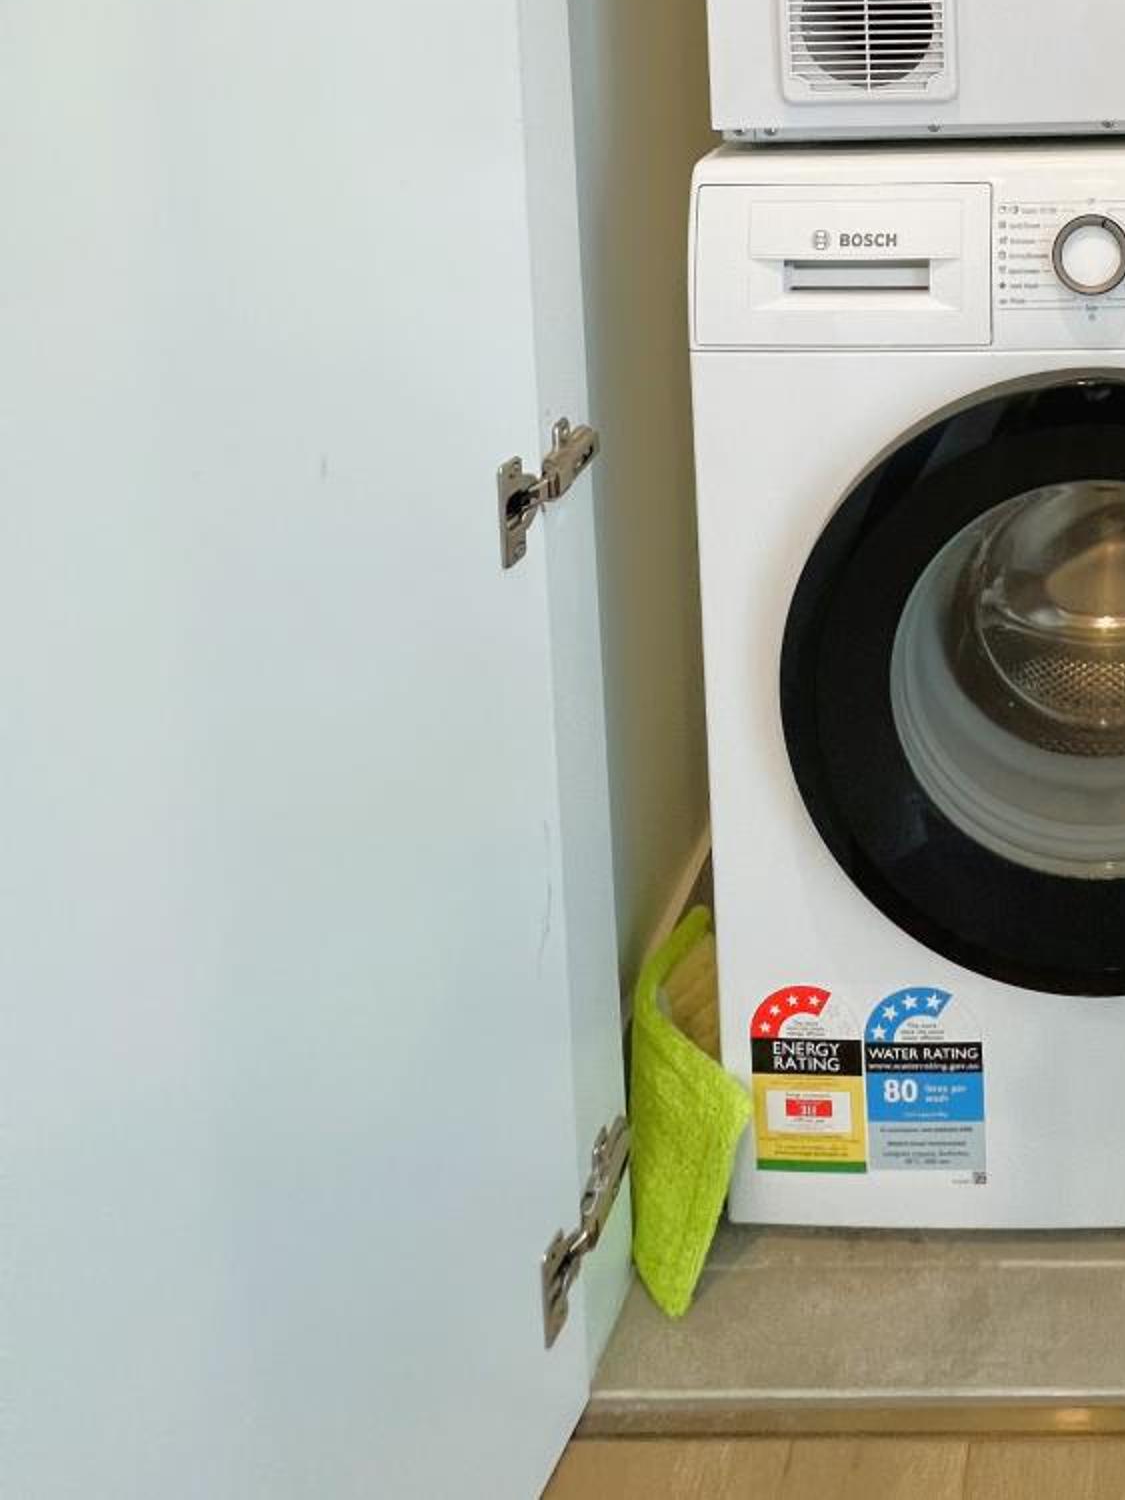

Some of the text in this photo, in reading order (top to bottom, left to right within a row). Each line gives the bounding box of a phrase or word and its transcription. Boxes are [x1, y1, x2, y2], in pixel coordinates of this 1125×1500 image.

[839, 233, 898, 248] BOSCH
[772, 1041, 840, 1058] ENERGY
[868, 1046, 979, 1061] WATER RATING
[773, 1056, 840, 1072] RATING
[883, 1078, 918, 1104] 80
